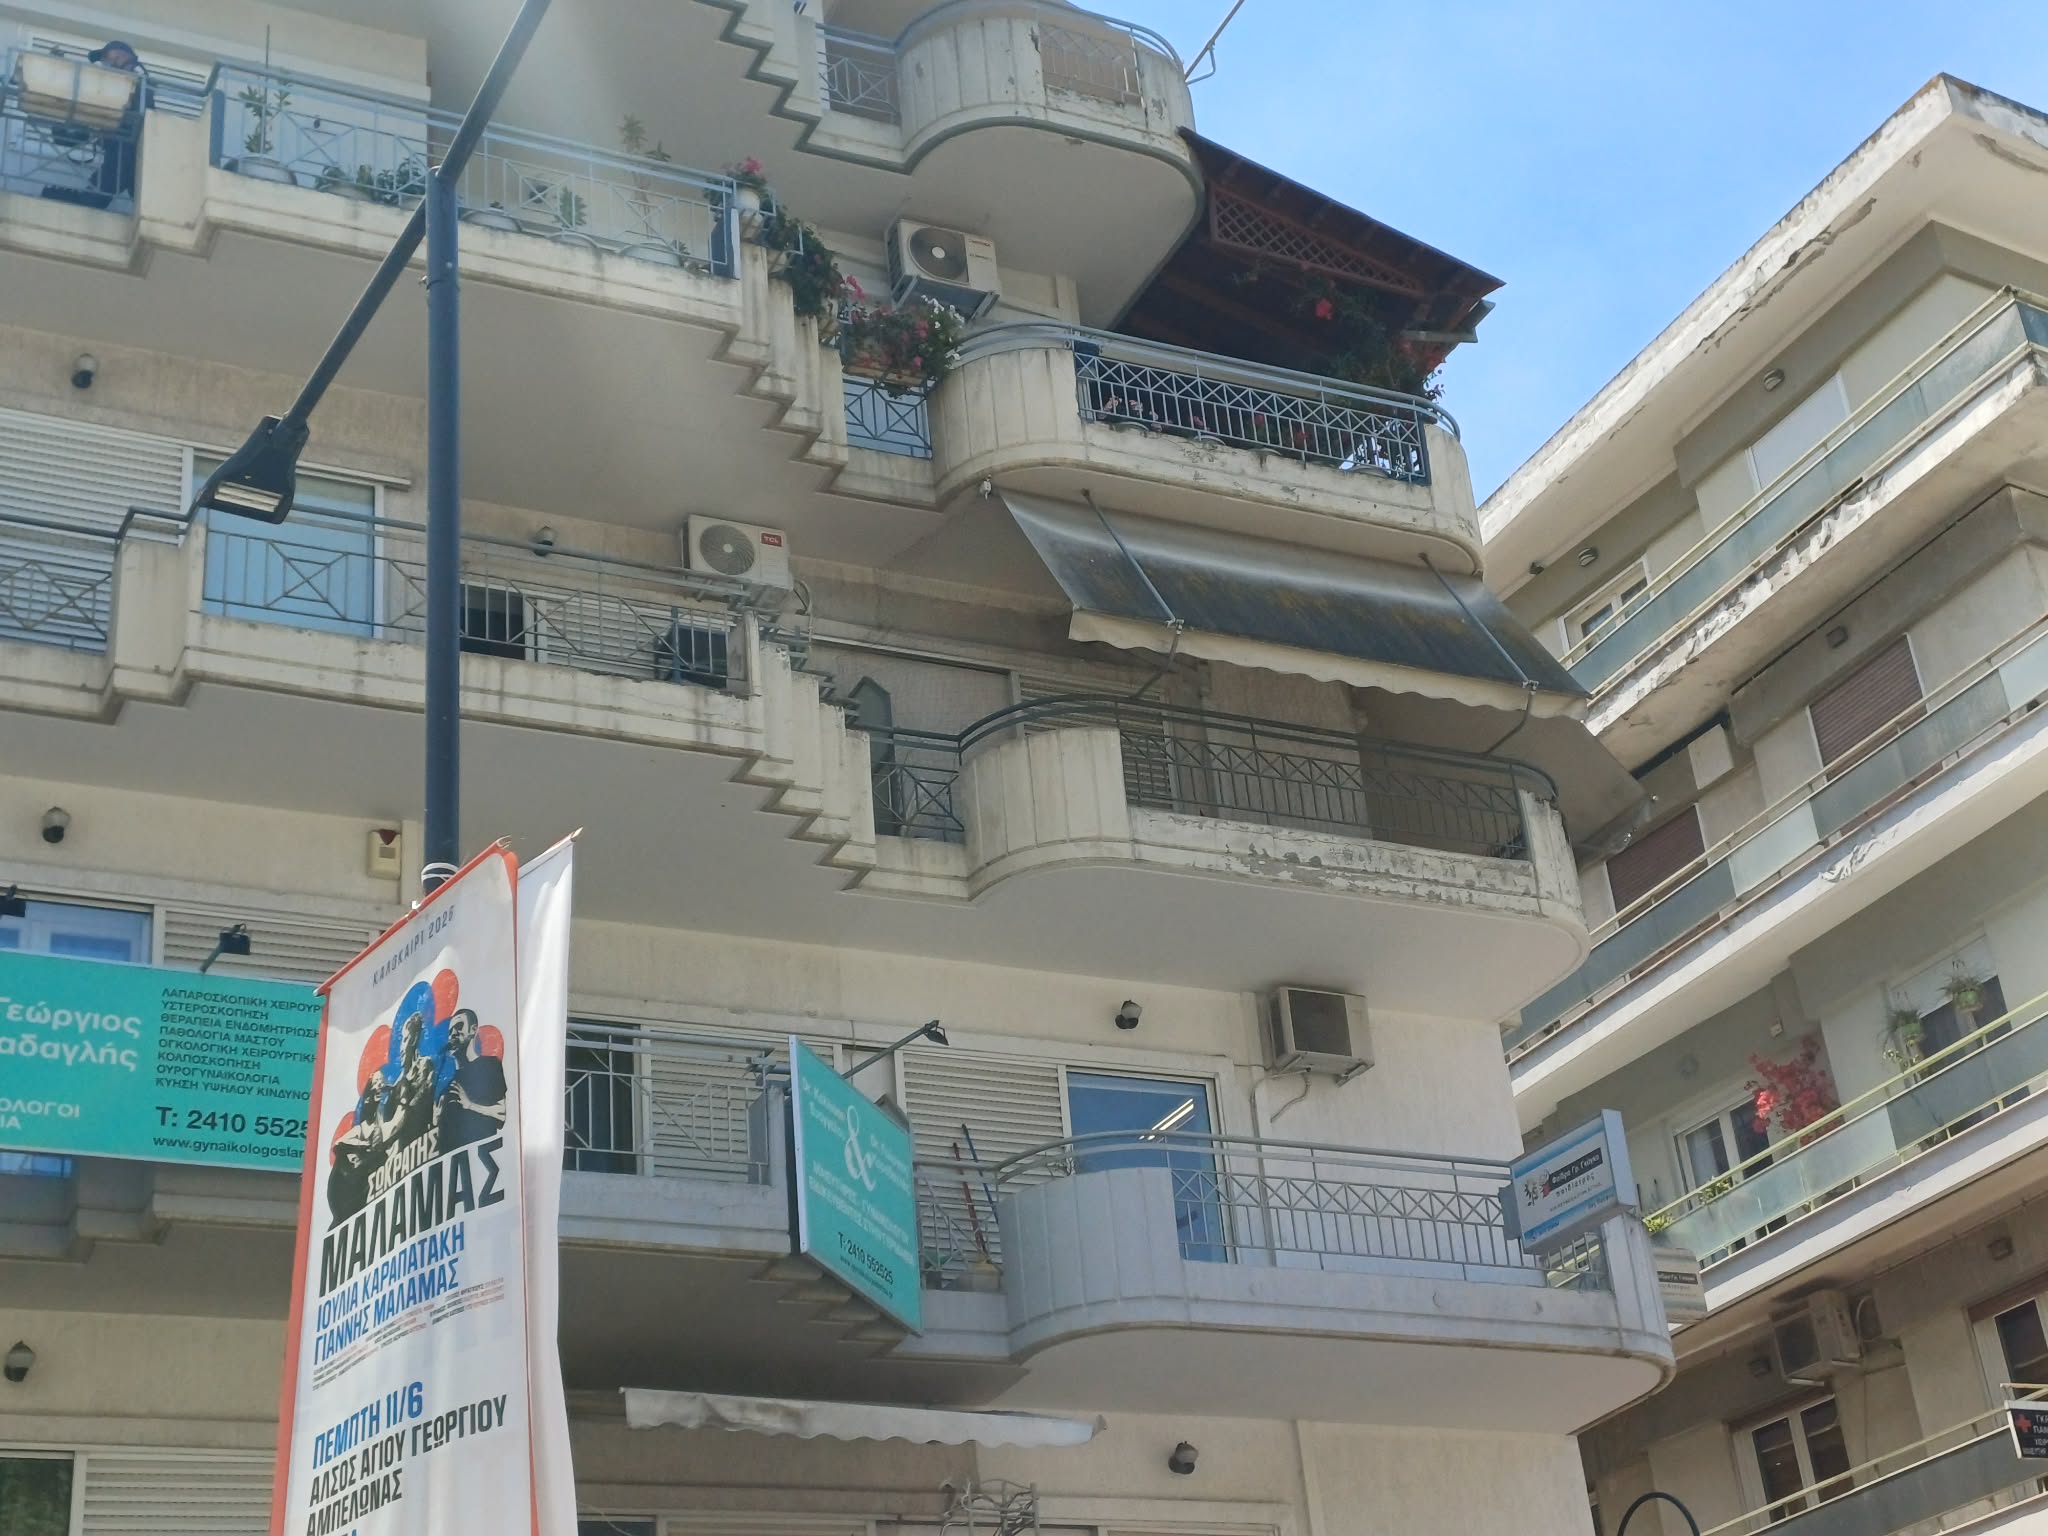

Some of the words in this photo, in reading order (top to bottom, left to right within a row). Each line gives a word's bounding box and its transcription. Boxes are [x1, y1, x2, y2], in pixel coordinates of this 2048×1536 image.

[763, 535, 779, 544] TCL
[373, 930, 424, 988] ΚΑΛΟΚΑΙΡΙ
[162, 988, 267, 1008] ΛΑΠΑΡΟΣΚΟΠΙΚΗ
[162, 1001, 269, 1020] ΥΣΤΕΡΟΣΚΟΠΗΣΗ
[161, 1013, 222, 1028] ΘΕΡΑΠΕΙΑ
[158, 1039, 237, 1055] ΟΓΚΟΛΟΓΙΚΗ
[160, 1026, 231, 1041] ΠΑΘΟΛΟΓΙΑ
[234, 1034, 285, 1047] ΜΑΣΤΟΥ
[156, 1064, 280, 1084] ΟΥΡΟΓΥΝΑΙΚΟΛΟΓΙΑ
[158, 1052, 260, 1070] ΚΟΛΠΟΣΚΟΠΗΣΗ
[156, 1078, 198, 1089] ΚΥΗΣΗ
[202, 1082, 254, 1095] ΥΨΗΛΟΥ
[155, 1106, 178, 1127] T:
[186, 1110, 246, 1133] 2410
[367, 1128, 439, 1199] ΣΩΚΡΑΤΗΣ
[319, 1137, 505, 1298] ΜΑΛΑΜΑΣ
[848, 1240, 865, 1264] 2410
[867, 1254, 893, 1285] 552525
[317, 1281, 358, 1332] ΙΟΥΛΙΑ
[361, 1221, 464, 1304] ΚΑΡΑΠΑΤΑΚΗ
[314, 1304, 371, 1365] ΓΙΑΝΝΗΣ
[374, 1258, 459, 1328] ΜΑΛΑΜΑΣ
[313, 1399, 380, 1469] ΠΕΜΠΤΗ
[309, 1454, 357, 1507] ΑΛΣΟΣ
[360, 1429, 405, 1480] ΑΓΙΟΥ
[411, 1394, 506, 1456] ΓΕΩΡΓΙΟΥ
[306, 1468, 402, 1536] ΑΜΠΕΛΩΝΑΣ
